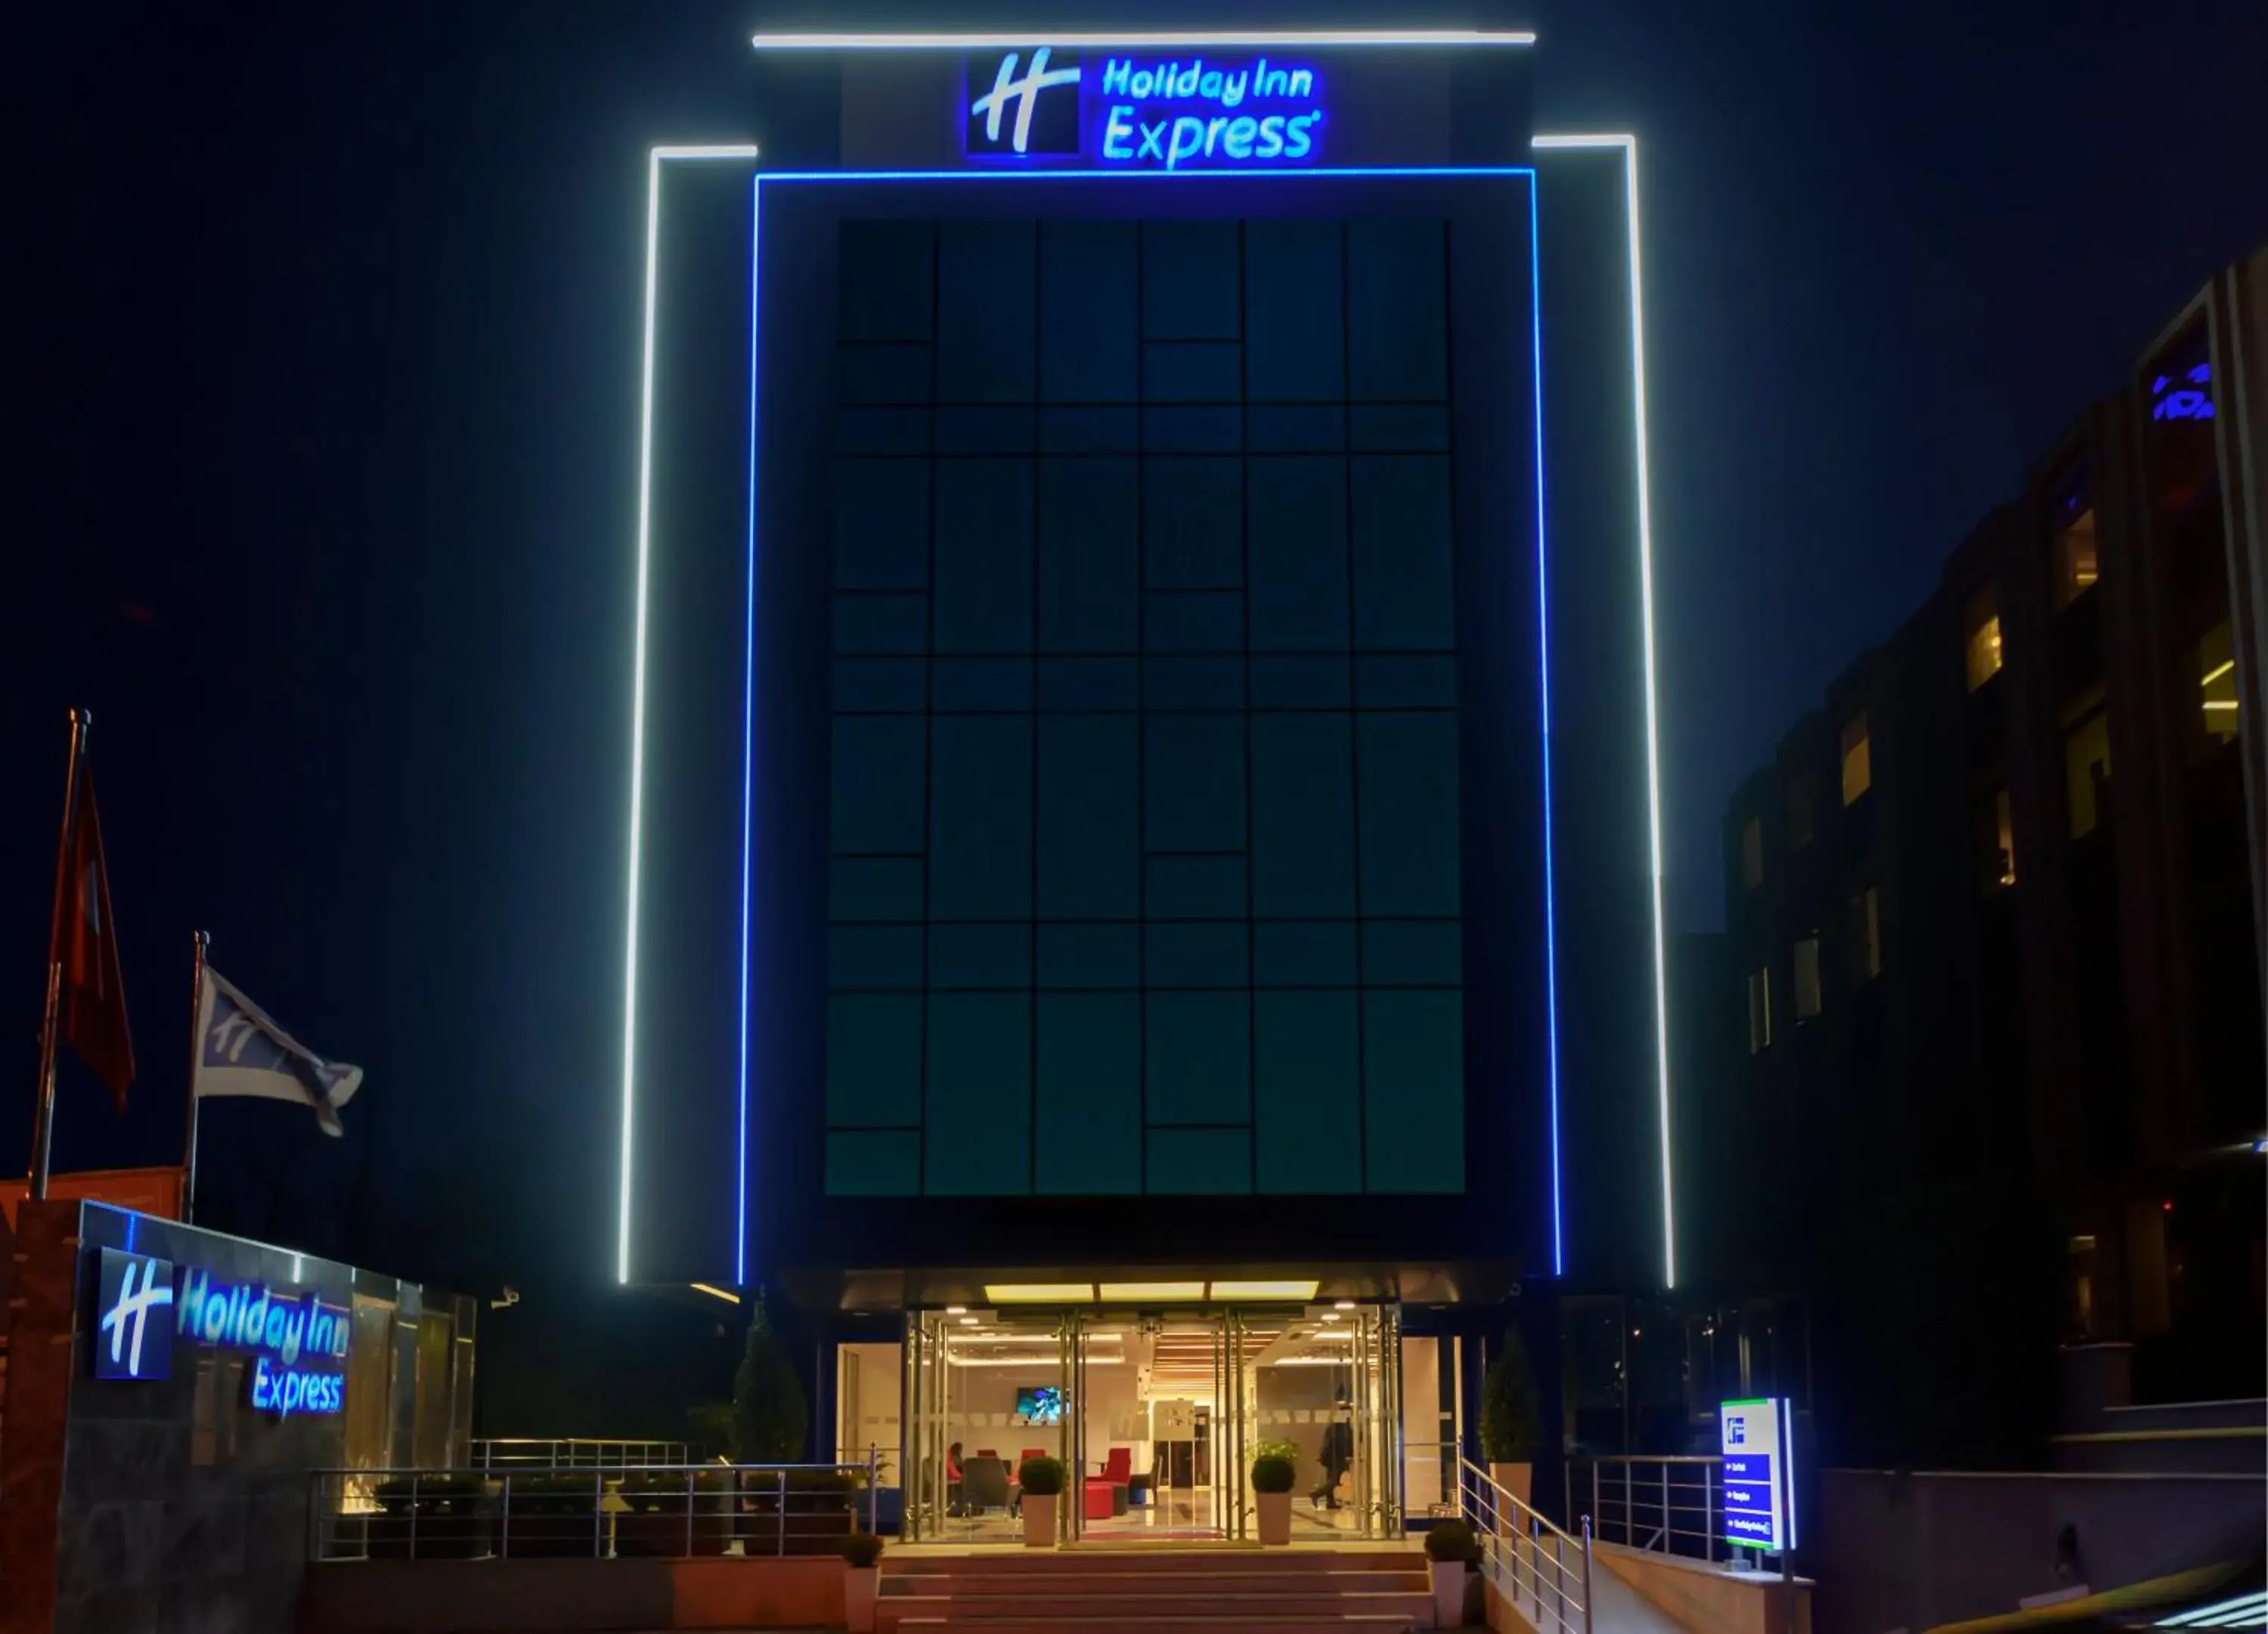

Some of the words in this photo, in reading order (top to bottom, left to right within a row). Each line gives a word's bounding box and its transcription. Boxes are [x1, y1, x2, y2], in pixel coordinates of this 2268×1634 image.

[1102, 58, 1248, 107] Holiday
[1253, 57, 1314, 98] Inn
[1101, 105, 1314, 172] Express
[178, 1265, 304, 1365] Holiday
[306, 1293, 351, 1357] Inn
[253, 1357, 342, 1421] Express
